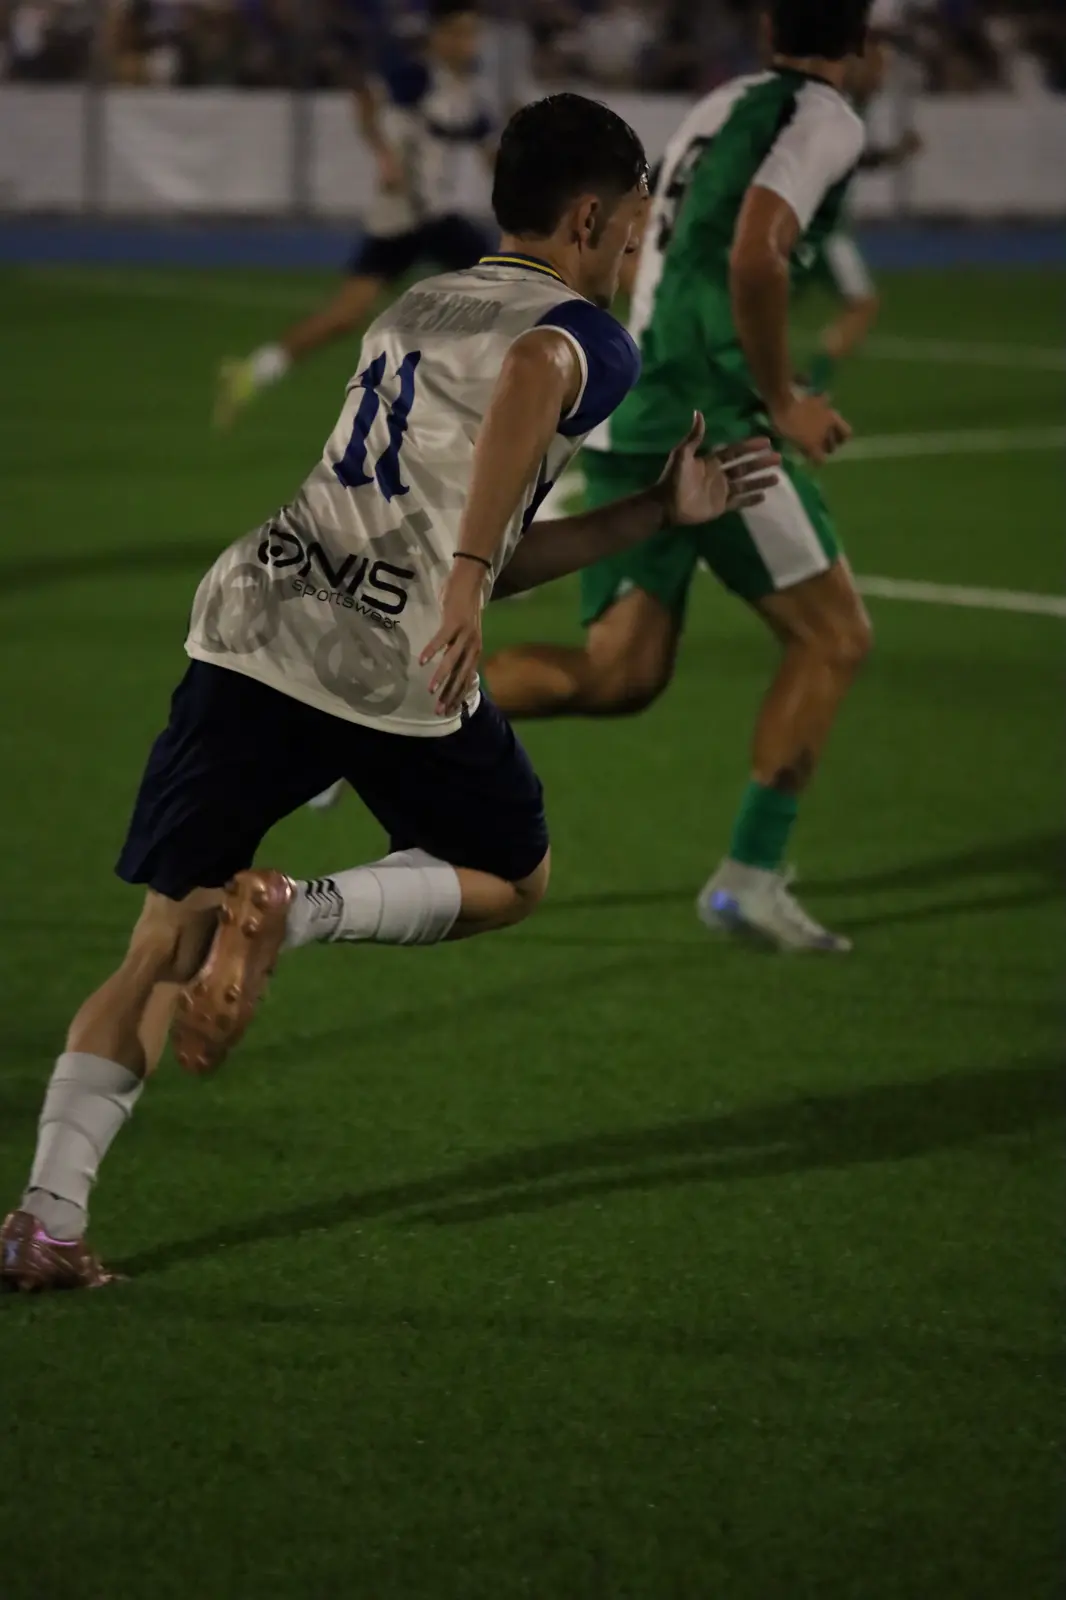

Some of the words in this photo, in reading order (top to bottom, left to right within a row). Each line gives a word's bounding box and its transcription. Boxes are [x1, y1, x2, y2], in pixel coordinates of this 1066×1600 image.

[333, 350, 421, 503] 11
[257, 528, 415, 615] ONIS
[291, 578, 401, 630] sportswear
